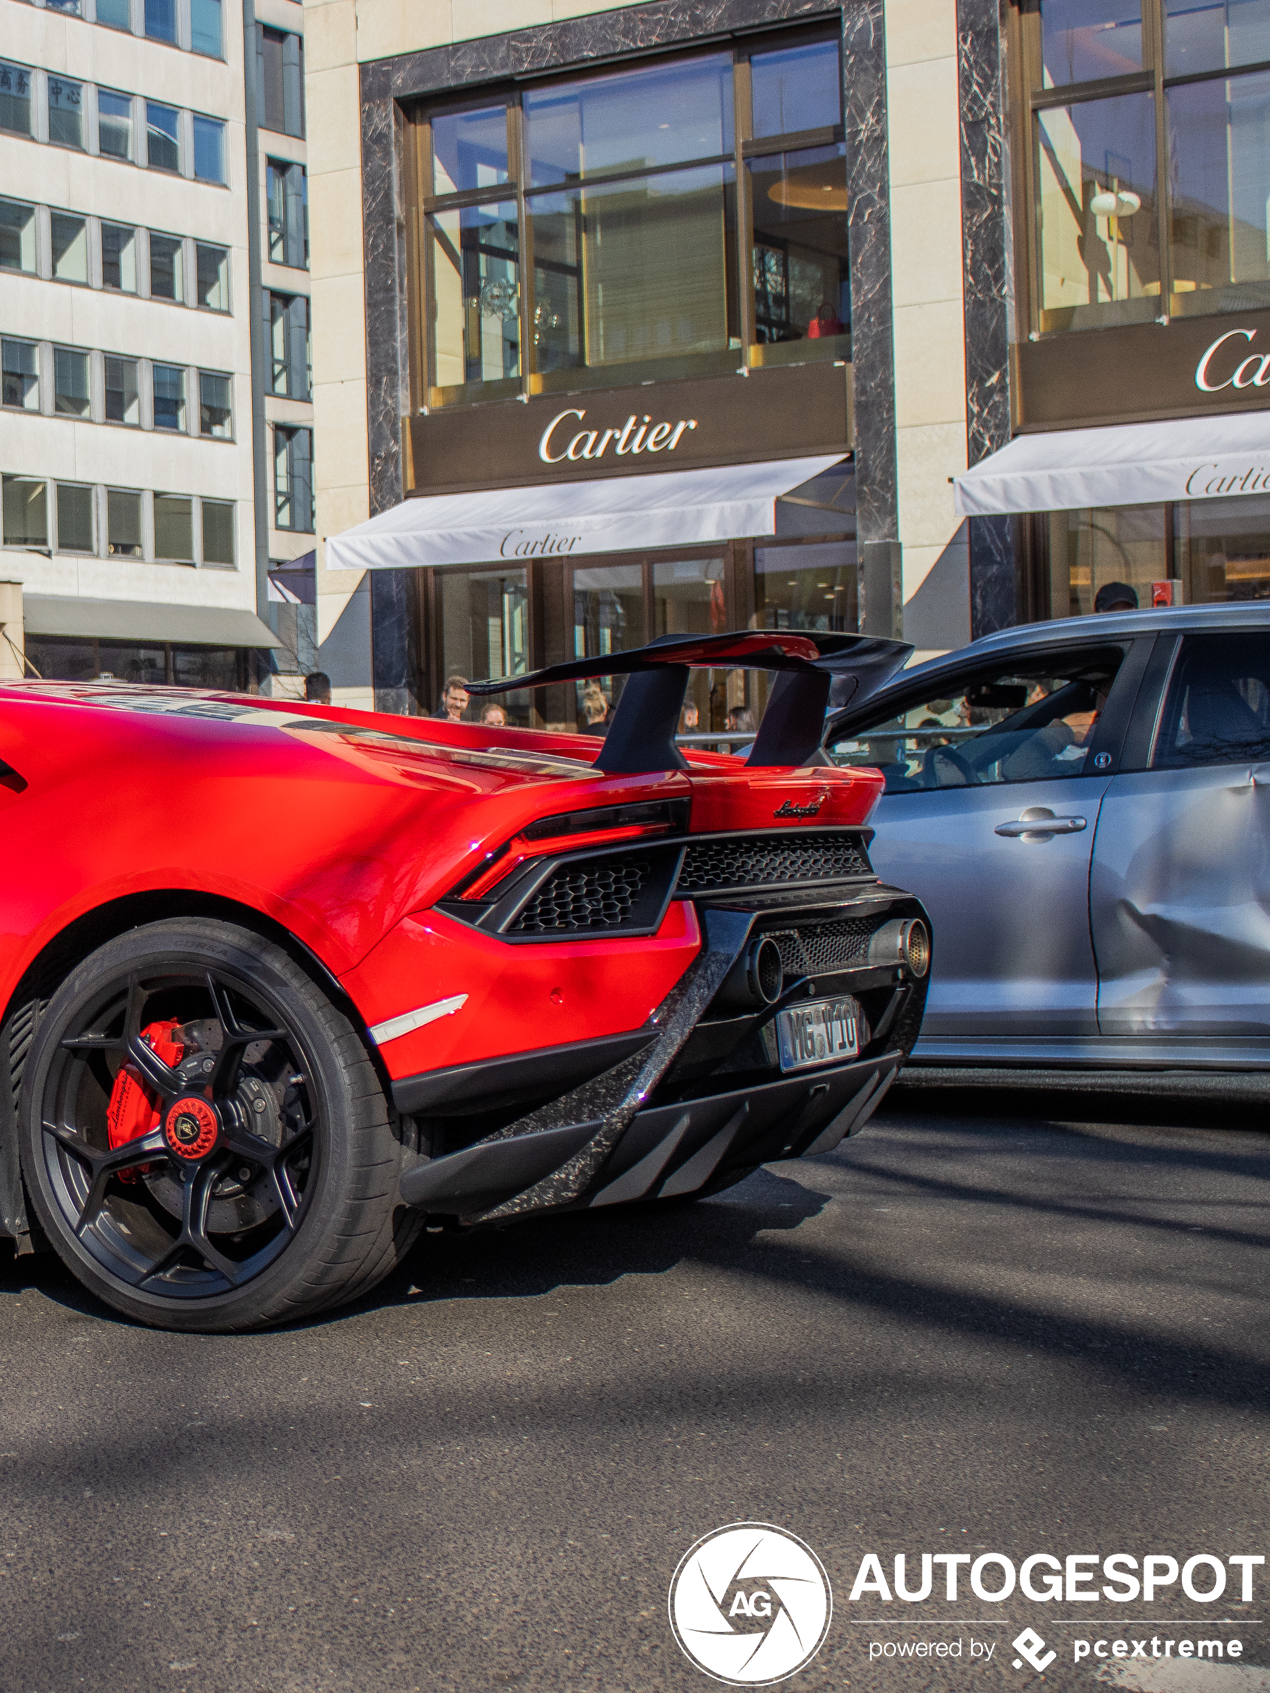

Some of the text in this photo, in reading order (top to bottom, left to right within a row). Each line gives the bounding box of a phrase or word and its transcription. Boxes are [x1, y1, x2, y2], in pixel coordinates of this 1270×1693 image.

[1195, 329, 1270, 392] Ca
[539, 409, 698, 463] Cartier
[499, 529, 582, 557] Cartier
